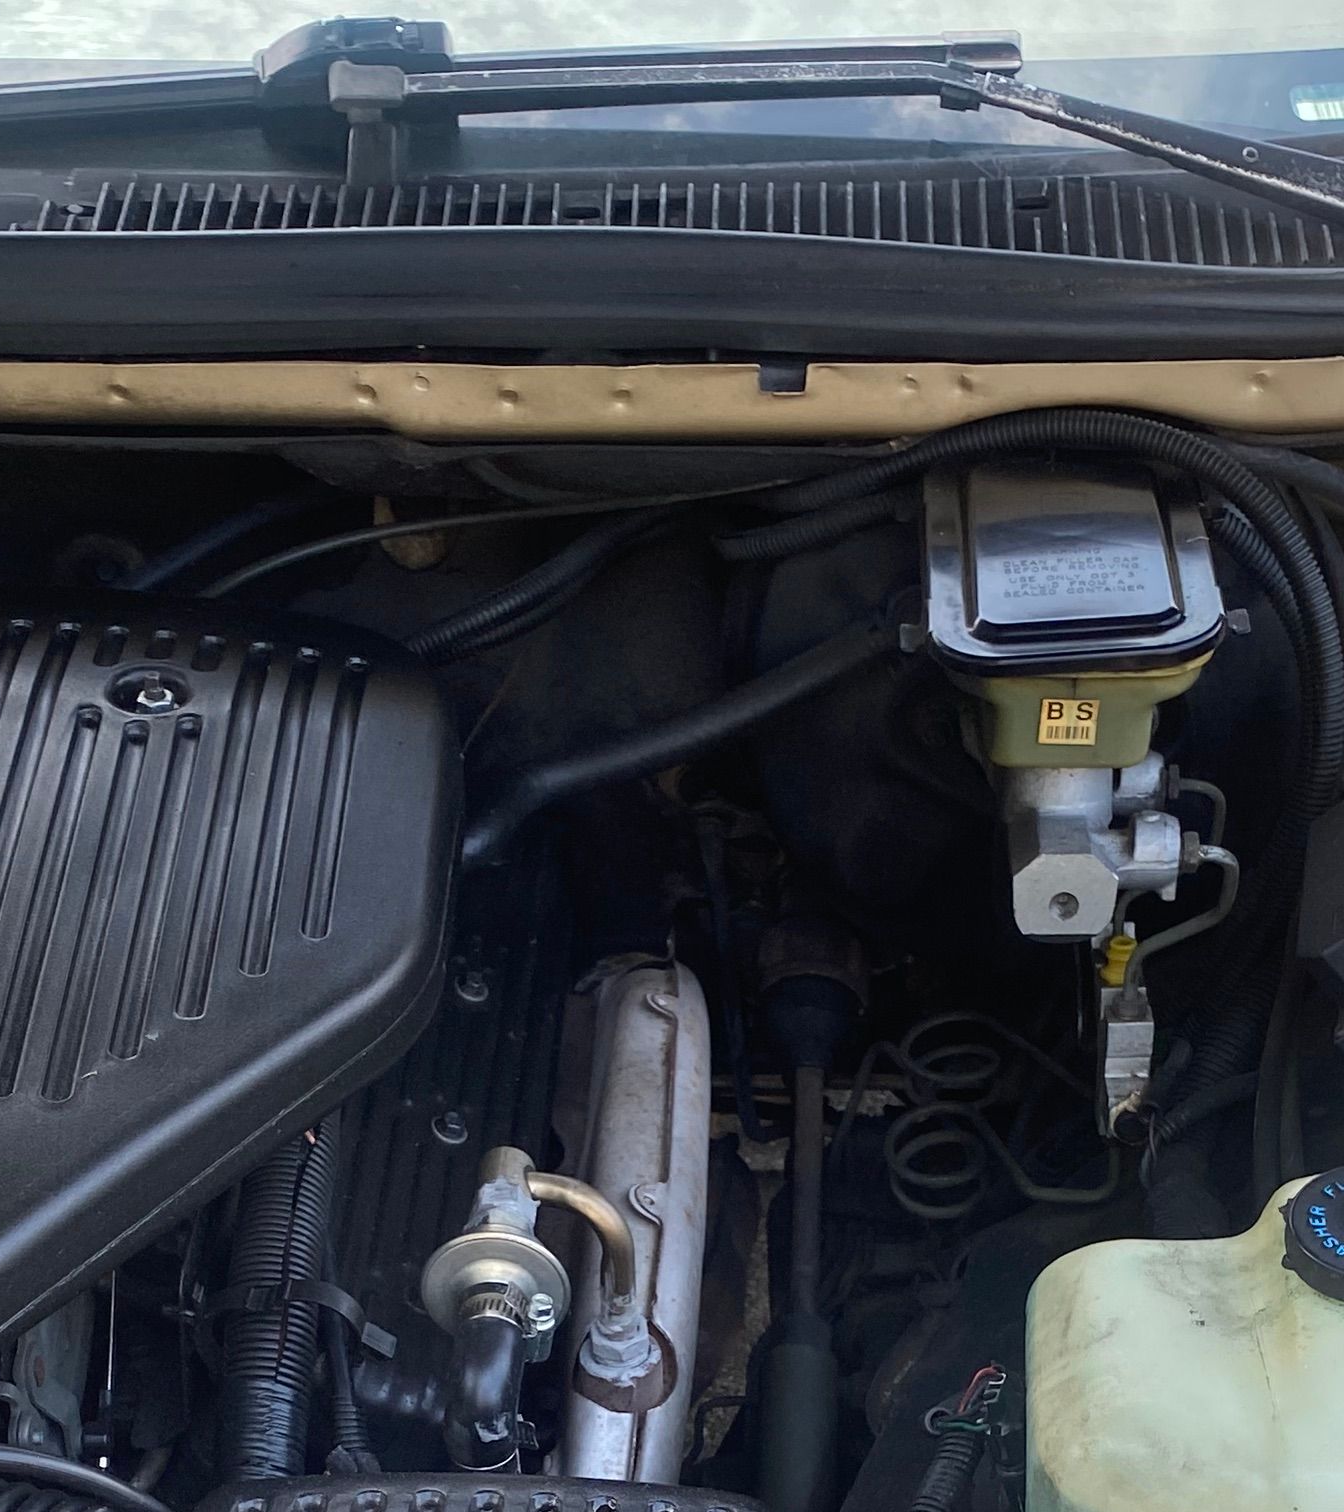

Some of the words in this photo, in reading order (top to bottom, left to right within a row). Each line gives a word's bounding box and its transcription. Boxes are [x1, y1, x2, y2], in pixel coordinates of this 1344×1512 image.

[1003, 559, 1048, 568] CLEAN
[1057, 556, 1103, 565] FILLER
[1004, 566, 1058, 574] BEFORE
[1046, 574, 1081, 582] ONLY
[1091, 571, 1117, 579] DOT
[1020, 581, 1059, 590] FLUID
[1070, 579, 1107, 587] FROM
[1004, 588, 1057, 598] SEALED
[1066, 584, 1145, 594] CONTAINER
